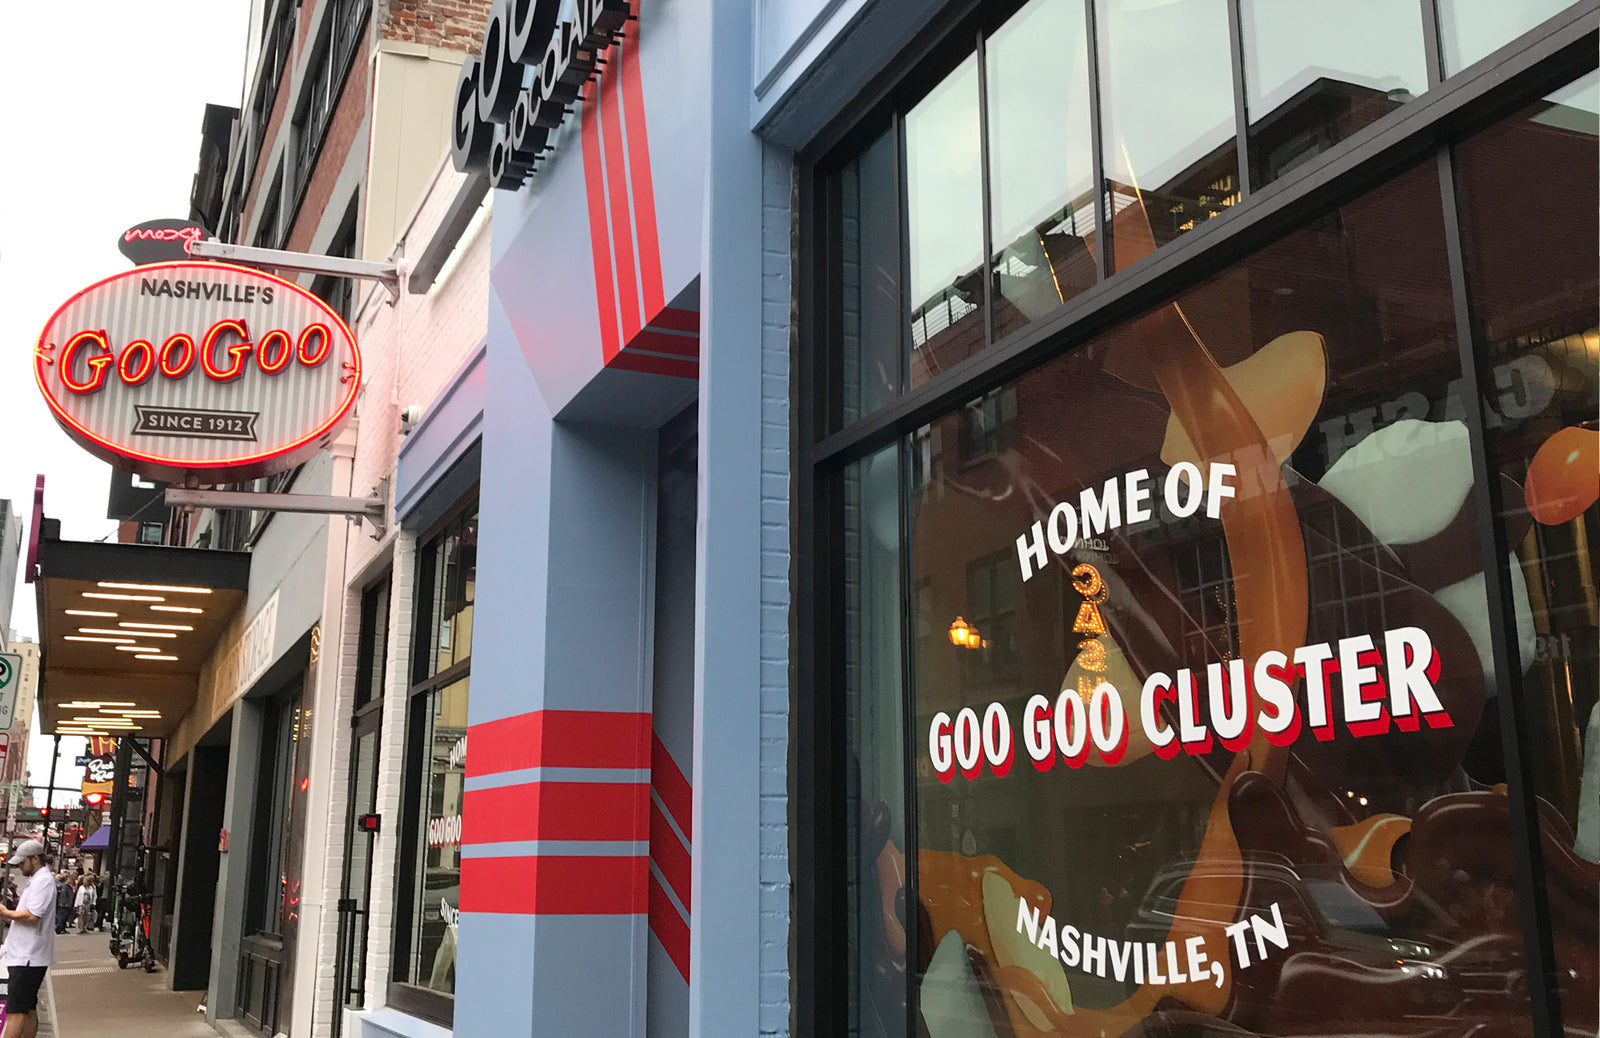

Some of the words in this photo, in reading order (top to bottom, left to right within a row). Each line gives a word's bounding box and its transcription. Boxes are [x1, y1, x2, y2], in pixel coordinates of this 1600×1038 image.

[140, 278, 274, 304] NASHVILLE'S
[148, 414, 202, 430] SINCE
[208, 416, 243, 432] 1912
[1016, 468, 1152, 582] HOME
[1164, 461, 1237, 520] OF
[928, 702, 1014, 783] GOO
[1022, 682, 1129, 772] GOO
[1140, 626, 1454, 760] CLUSTER
[450, 735, 467, 770] HOM
[429, 818, 444, 848] GOO
[445, 814, 462, 847] GOO
[1015, 896, 1224, 988] NASHVILLE,
[1226, 902, 1290, 970] TN
